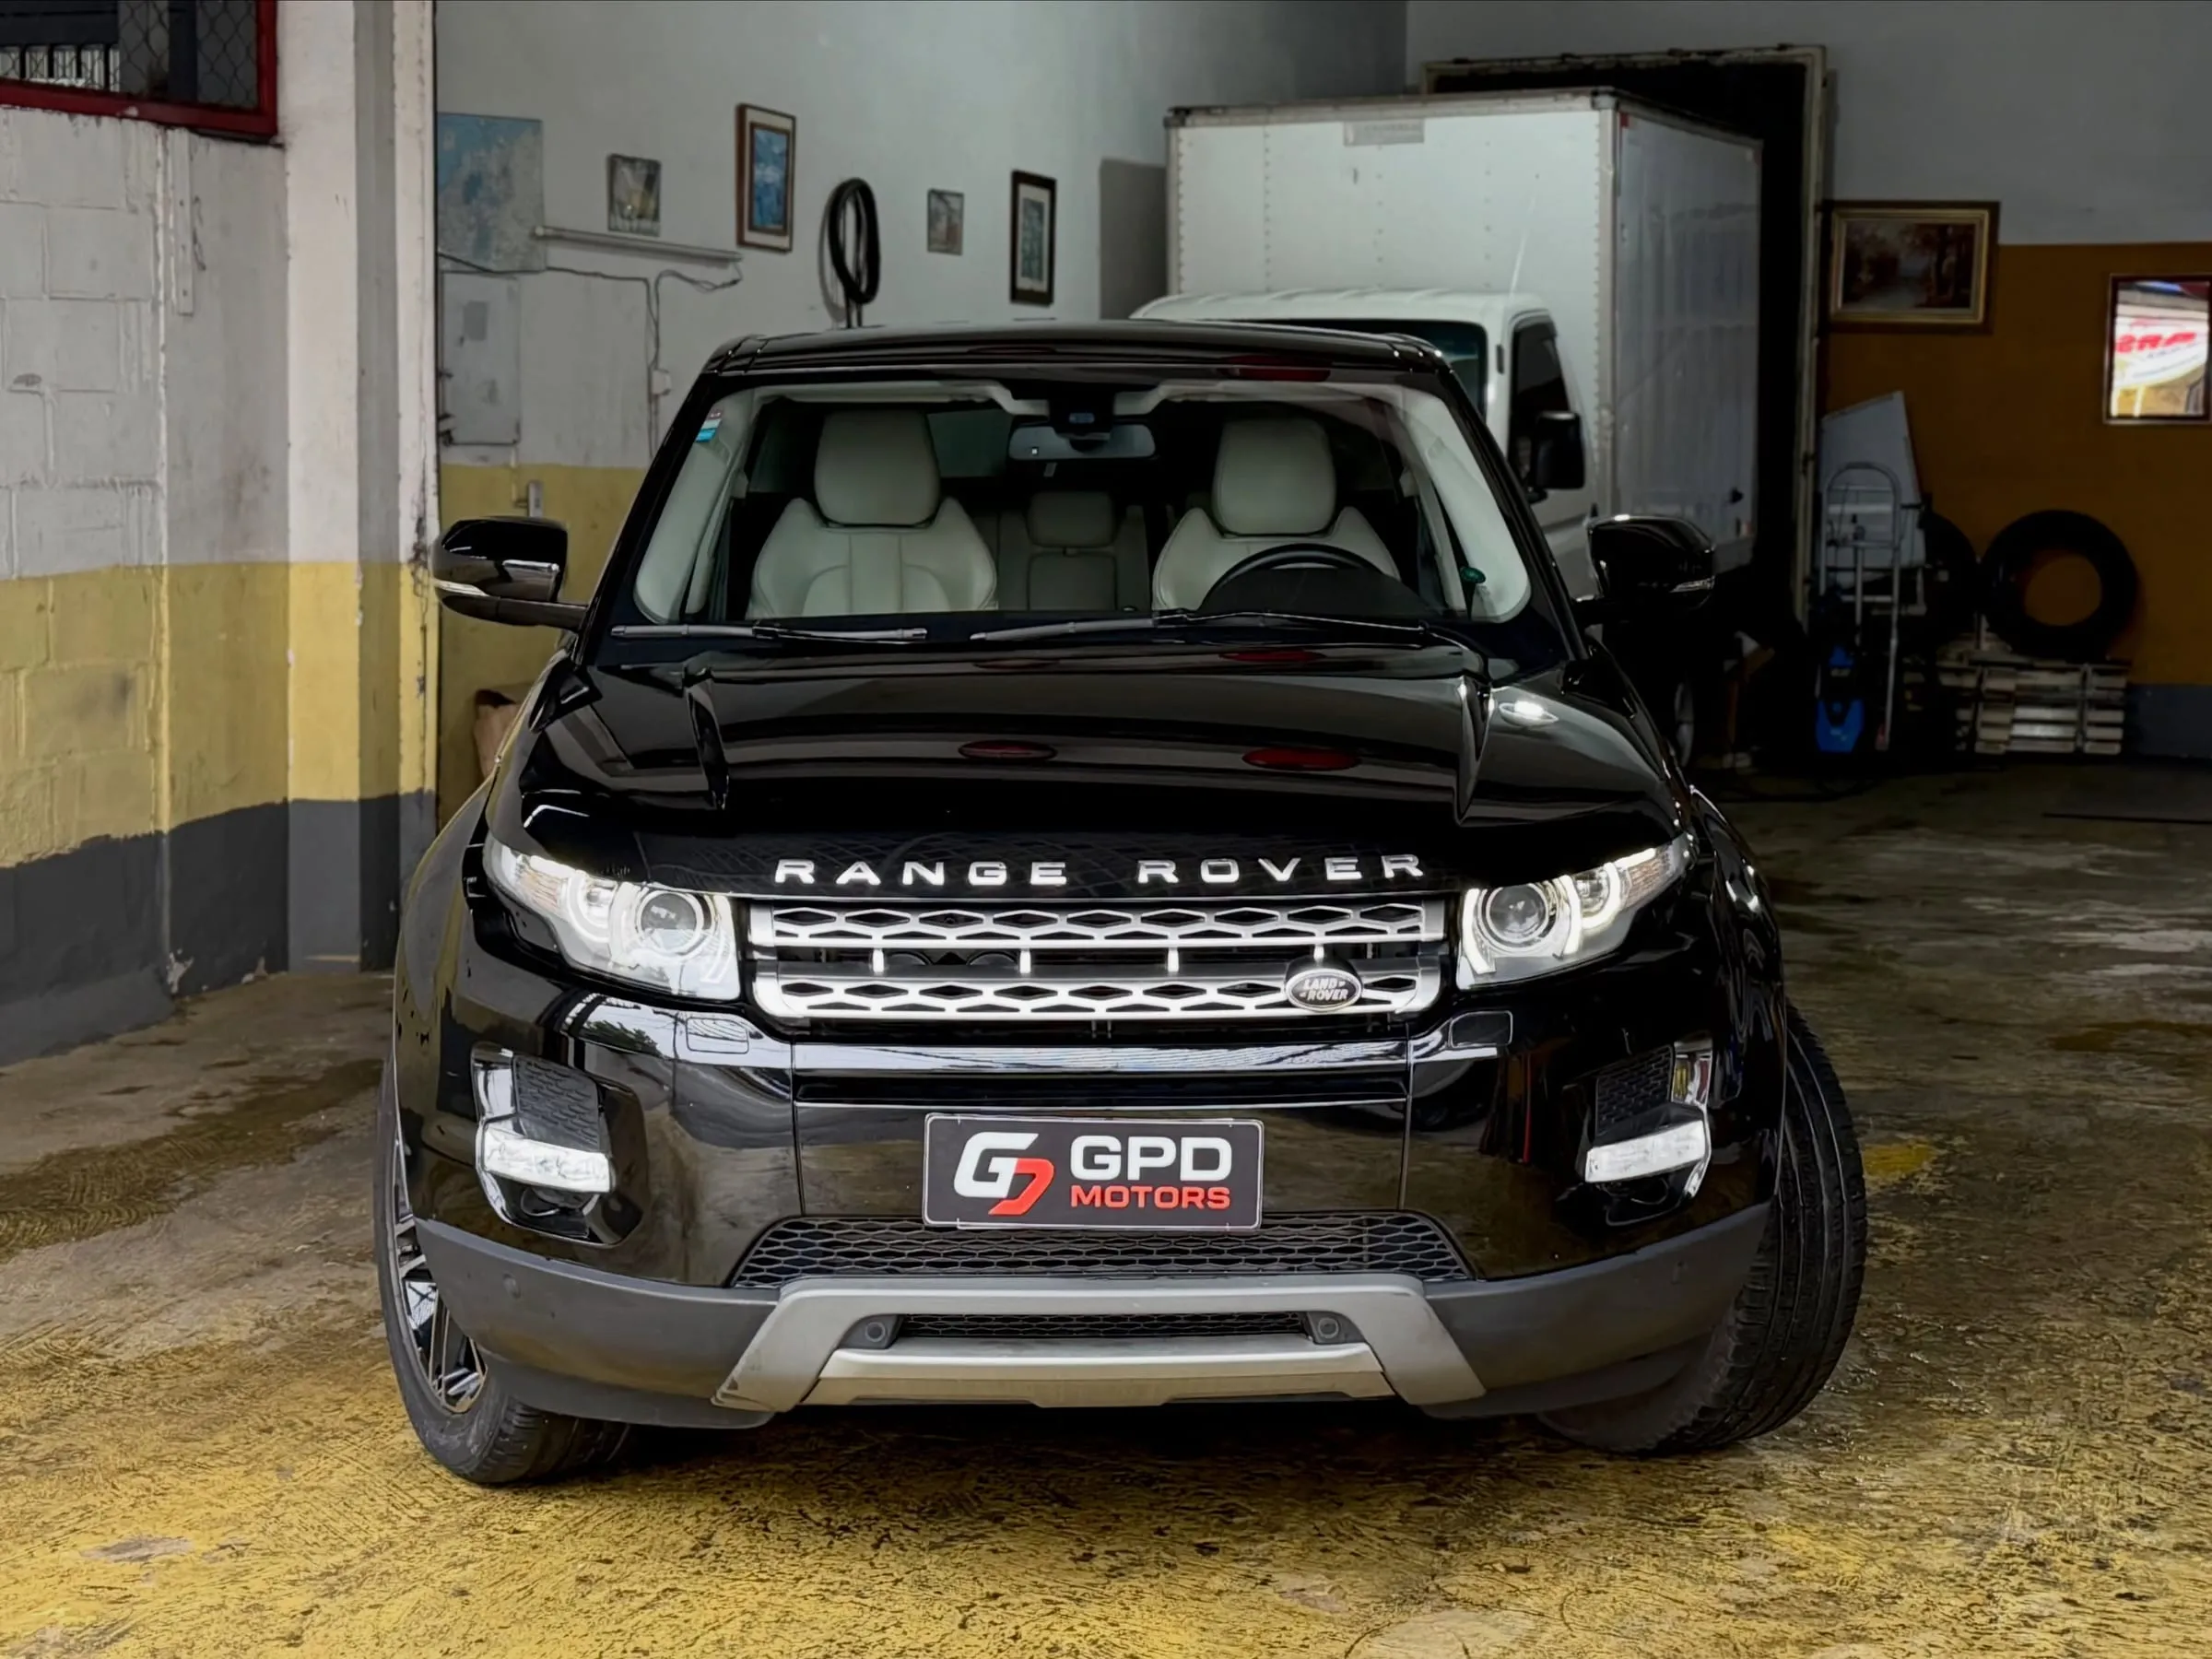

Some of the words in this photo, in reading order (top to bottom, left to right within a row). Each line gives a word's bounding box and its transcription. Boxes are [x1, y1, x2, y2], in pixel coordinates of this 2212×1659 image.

[774, 859, 1067, 887] RANGE
[1137, 854, 1424, 885] ROVER
[1303, 978, 1338, 990] LAND
[1307, 989, 1348, 1001] ROVER
[1071, 1135, 1232, 1182] GPD
[1071, 1185, 1230, 1210] MOTORS
